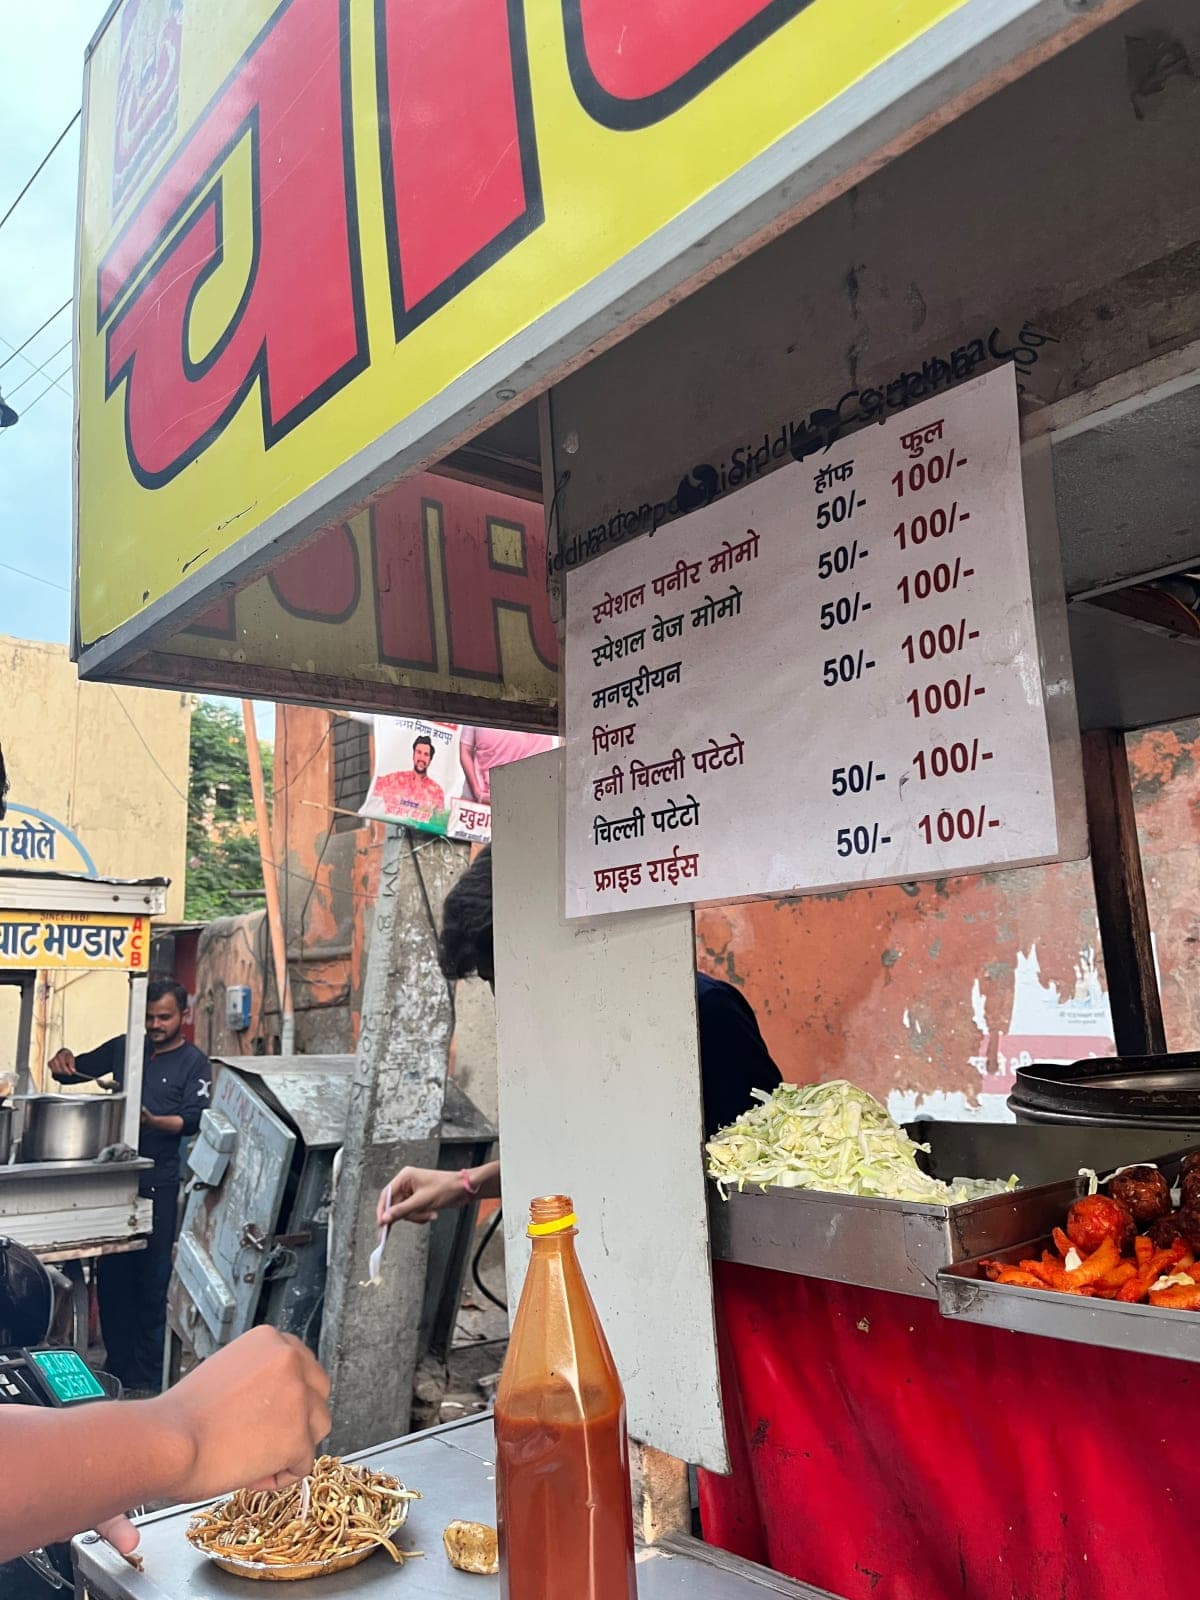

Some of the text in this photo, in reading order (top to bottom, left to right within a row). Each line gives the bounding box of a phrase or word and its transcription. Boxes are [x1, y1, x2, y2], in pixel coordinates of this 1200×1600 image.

[900, 419, 944, 458] फुल
[592, 448, 967, 624] स्पेशल पनीर मोमो 50/- 100/-
[592, 502, 970, 667] स्पेशल वेज मोमो 50/- 100/-
[592, 557, 974, 708] मनचूरीयन 50/- 100/-
[592, 618, 979, 755] पिंगर 50/- 100/-
[593, 674, 985, 801] हनी चिल्ली पटेटो 100/-
[593, 738, 993, 845] चिल्ली पटेटो 50/- 100/-
[459, 808, 492, 831] खुश
[594, 806, 1000, 893] फ्राइड राईस 50/- 100/-
[43, 923, 129, 959] भण्डार
